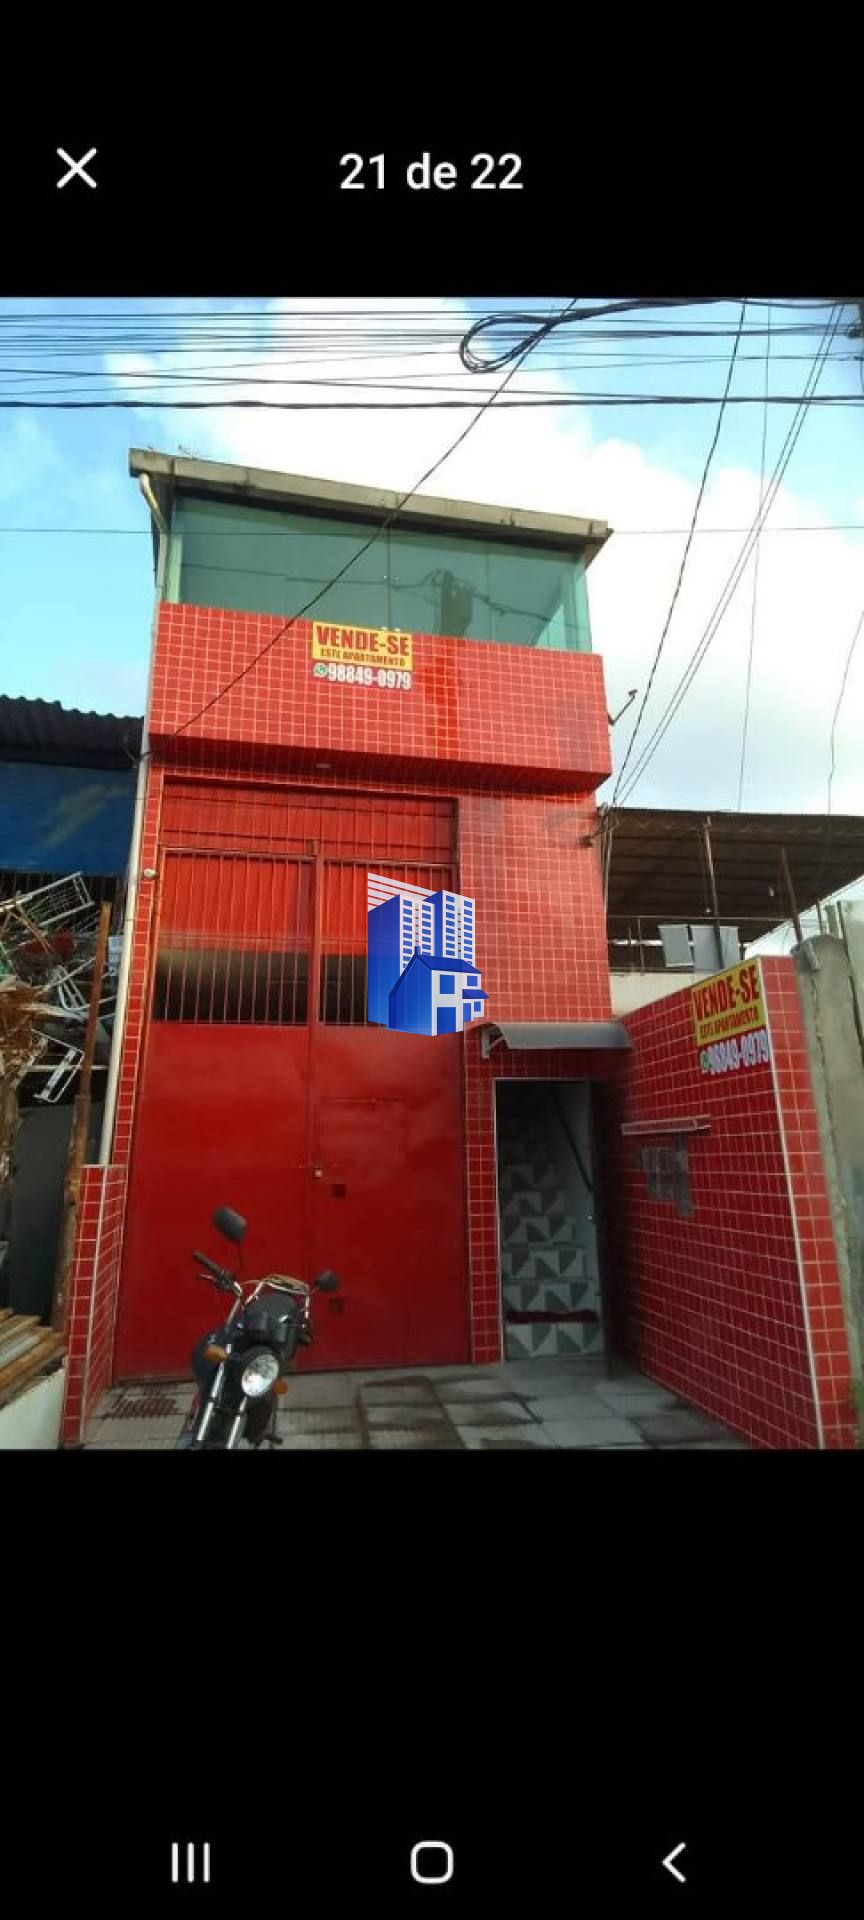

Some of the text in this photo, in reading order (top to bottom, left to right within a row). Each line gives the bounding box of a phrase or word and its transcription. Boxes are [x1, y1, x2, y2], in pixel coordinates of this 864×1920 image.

[316, 625, 410, 656] VENDE-SE
[328, 662, 411, 690] 98849-0979
[693, 964, 760, 1021] VENDE-SE
